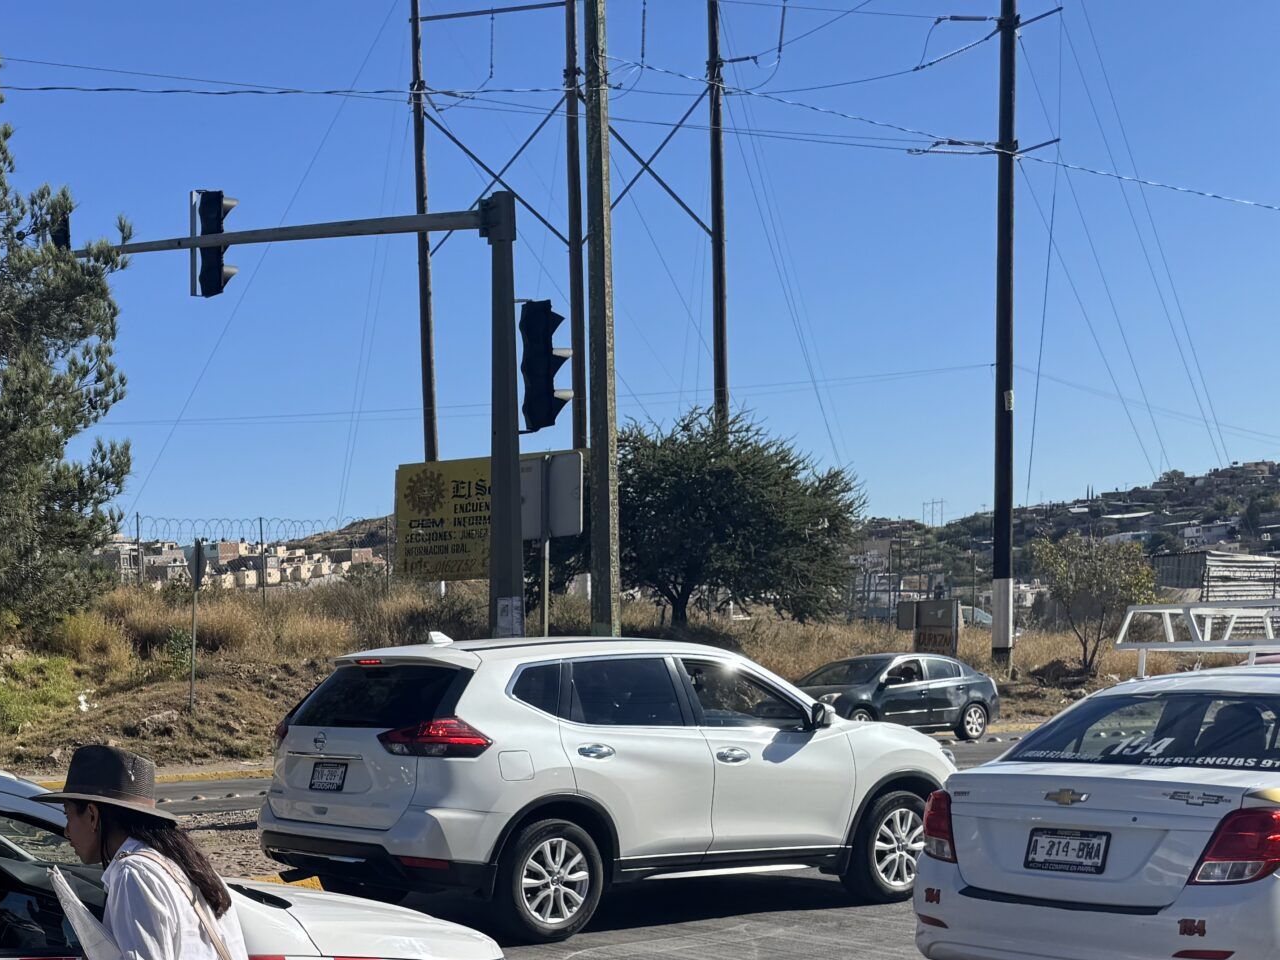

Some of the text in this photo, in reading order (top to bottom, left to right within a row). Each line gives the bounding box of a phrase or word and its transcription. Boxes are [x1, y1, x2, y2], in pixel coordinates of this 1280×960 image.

[451, 479, 472, 500] El
[1110, 736, 1176, 757] 154
[1140, 756, 1257, 767] EMERGENCIAS
